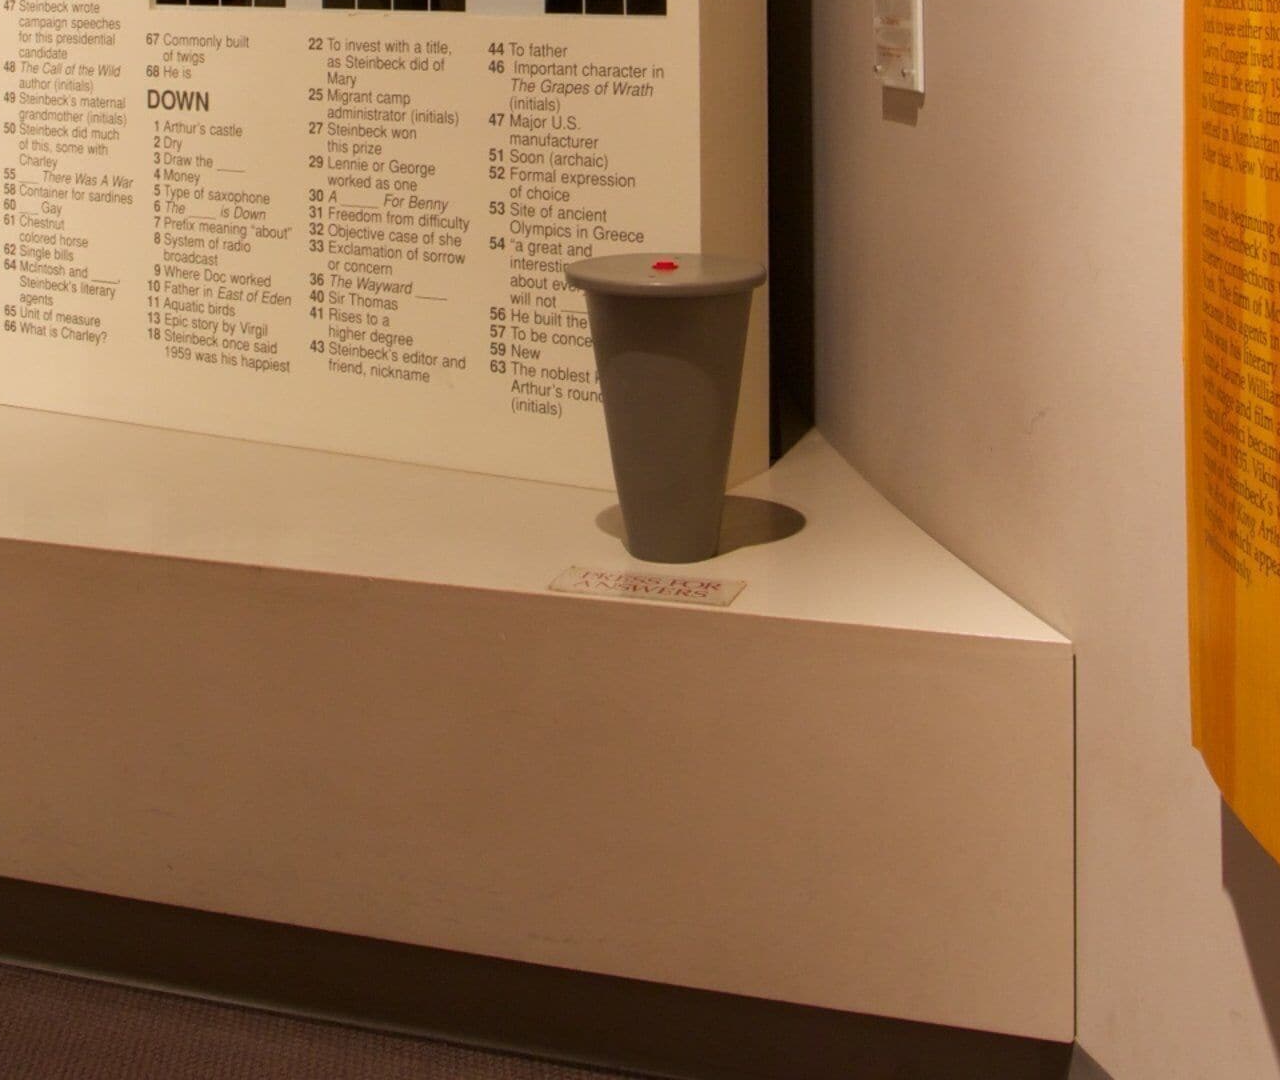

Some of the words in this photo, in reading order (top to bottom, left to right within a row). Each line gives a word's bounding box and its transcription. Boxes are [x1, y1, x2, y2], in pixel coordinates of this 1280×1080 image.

[488, 42, 504, 56] 44
[508, 42, 524, 56] To
[529, 43, 568, 58] father
[488, 60, 505, 74] 46
[514, 60, 578, 78] Important
[582, 63, 647, 78] character
[652, 65, 664, 78] in
[511, 78, 536, 92] The
[540, 79, 590, 96] Grapes
[594, 81, 609, 95] of
[613, 81, 654, 96] Wrath
[148, 89, 209, 112] DOWN
[509, 96, 560, 114] (initials)
[154, 120, 159, 132] 1
[163, 120, 206, 135] Arthur's
[210, 124, 243, 137] castle
[488, 113, 504, 126] 47
[510, 113, 547, 131] Major
[552, 116, 580, 130] U.S.
[154, 136, 161, 148] 2
[164, 136, 182, 152] Dry
[510, 133, 599, 149] manufacturer
[489, 148, 503, 162] 51
[510, 149, 544, 164] Soon
[550, 152, 608, 170] (archaic)
[309, 290, 324, 303] 40
[329, 290, 345, 304] Sir
[348, 292, 398, 310] Thomas
